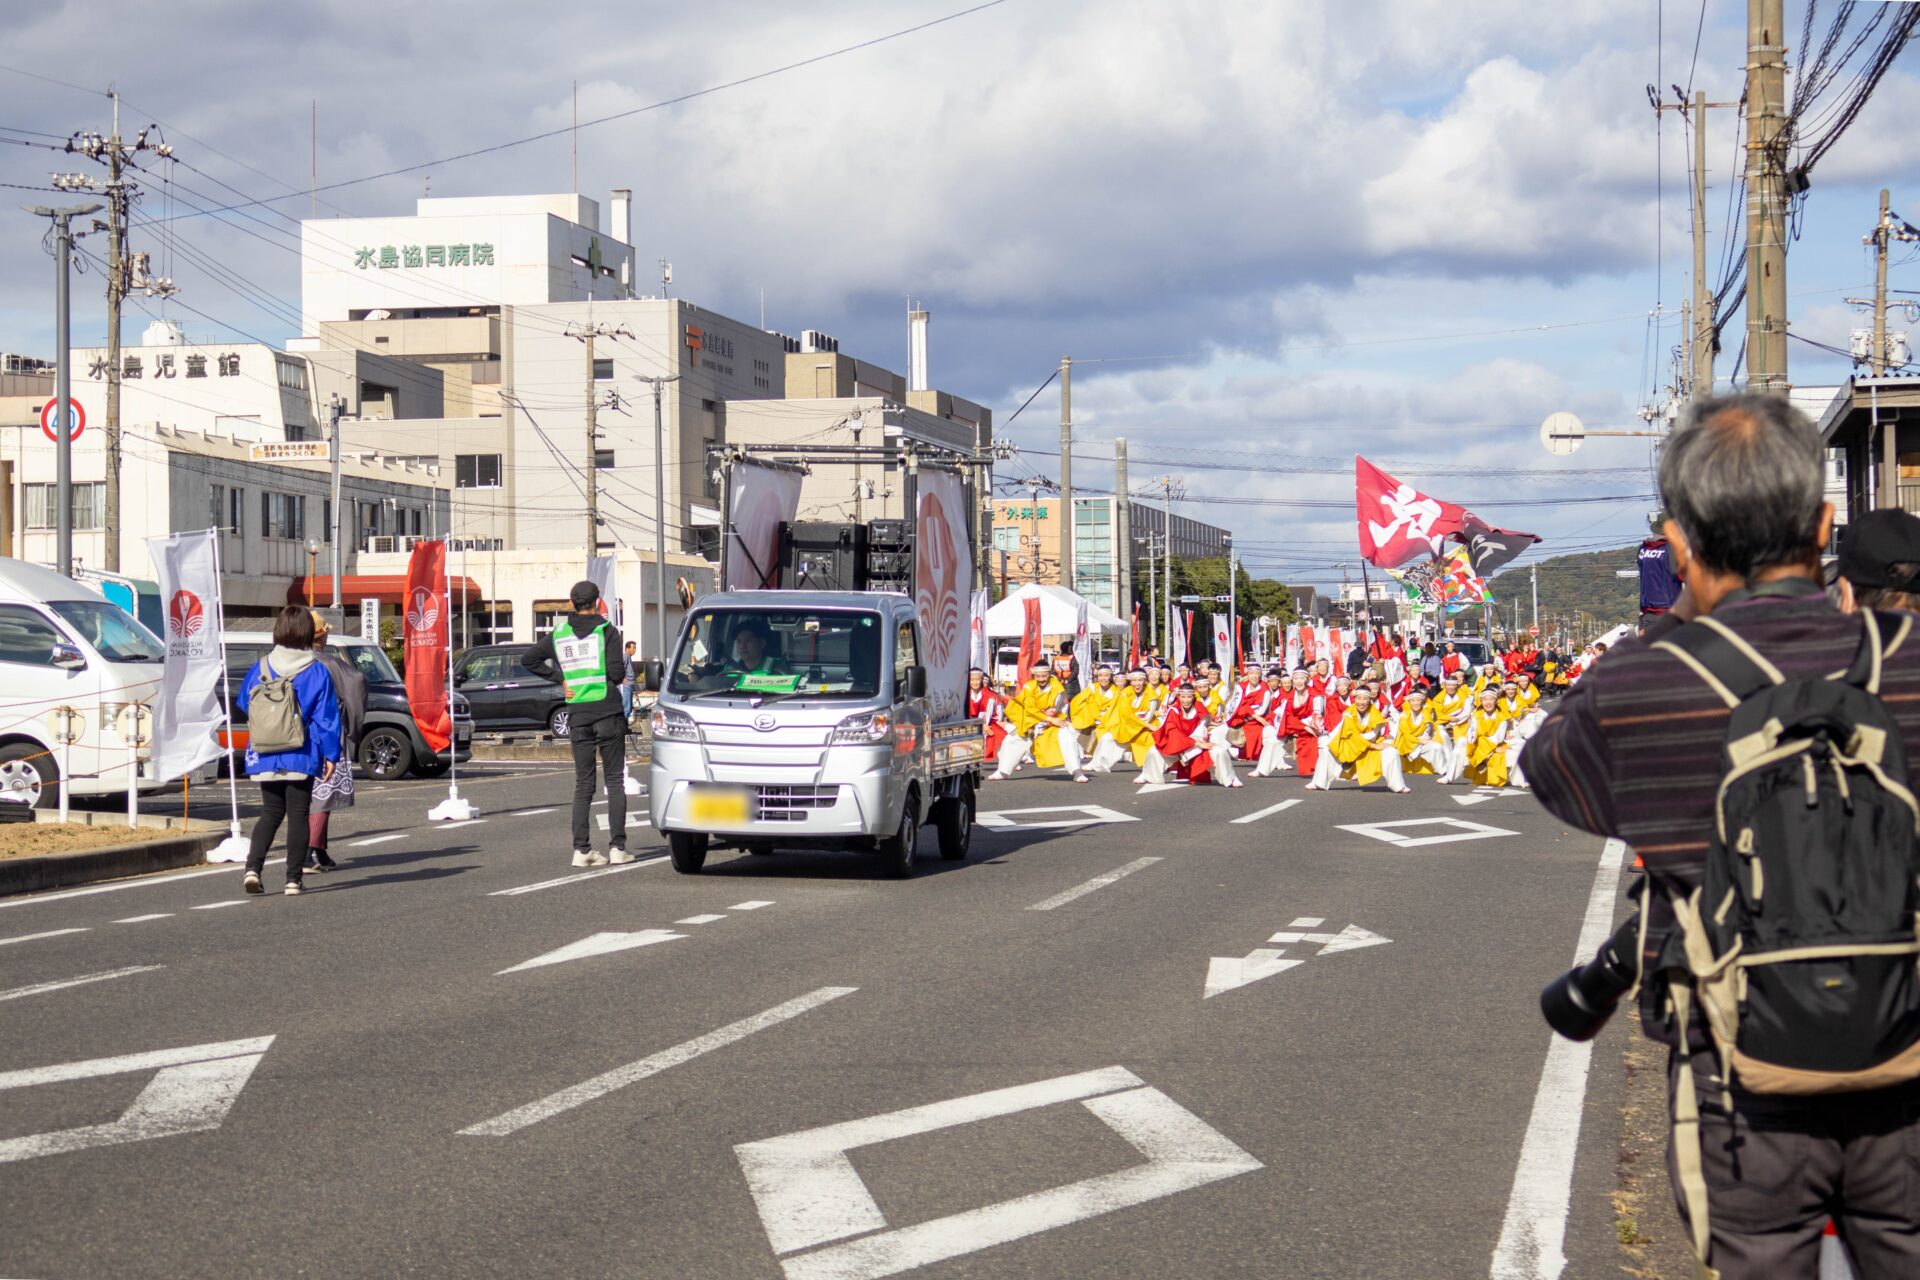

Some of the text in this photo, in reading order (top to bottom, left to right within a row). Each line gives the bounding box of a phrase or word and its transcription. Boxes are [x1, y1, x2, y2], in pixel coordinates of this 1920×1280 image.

[354, 242, 495, 270] 水島協同病院
[88, 352, 241, 381] 水島児童館
[563, 642, 591, 658] 音響
